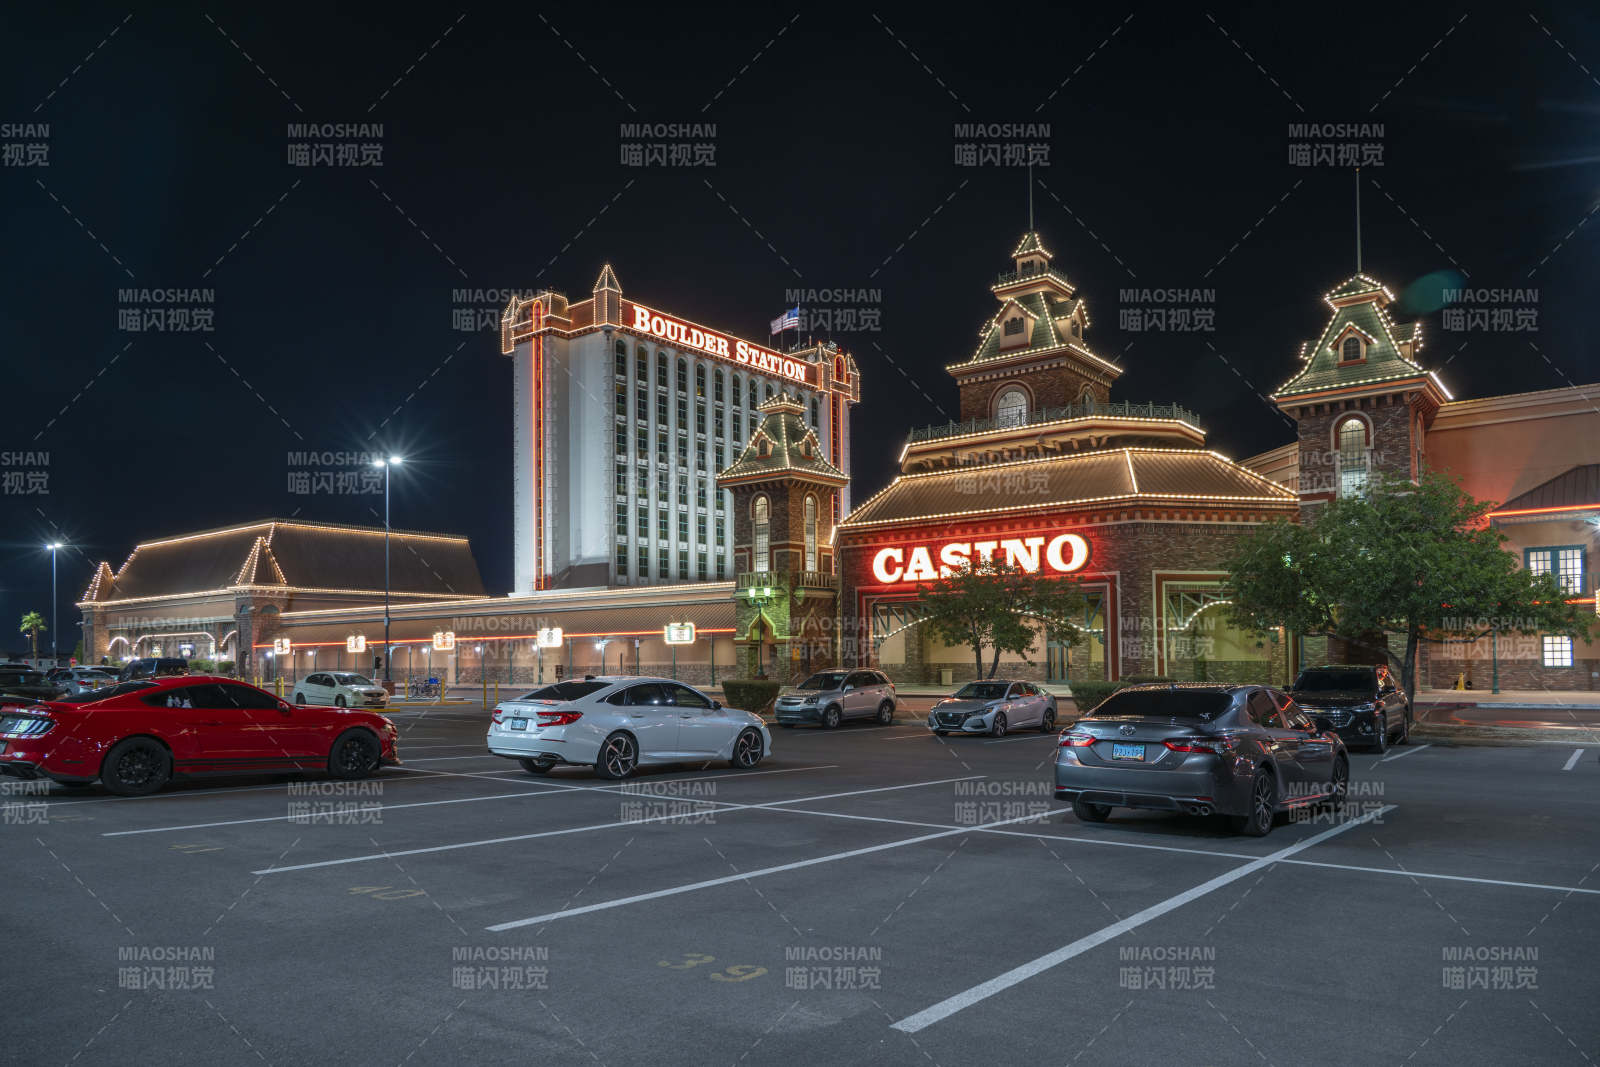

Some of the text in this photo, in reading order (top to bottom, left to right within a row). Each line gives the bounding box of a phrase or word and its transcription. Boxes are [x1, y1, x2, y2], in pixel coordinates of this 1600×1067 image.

[633, 305, 806, 381] BOULDER STATION
[873, 534, 1088, 583] CASINO
[656, 953, 768, 982] 39
